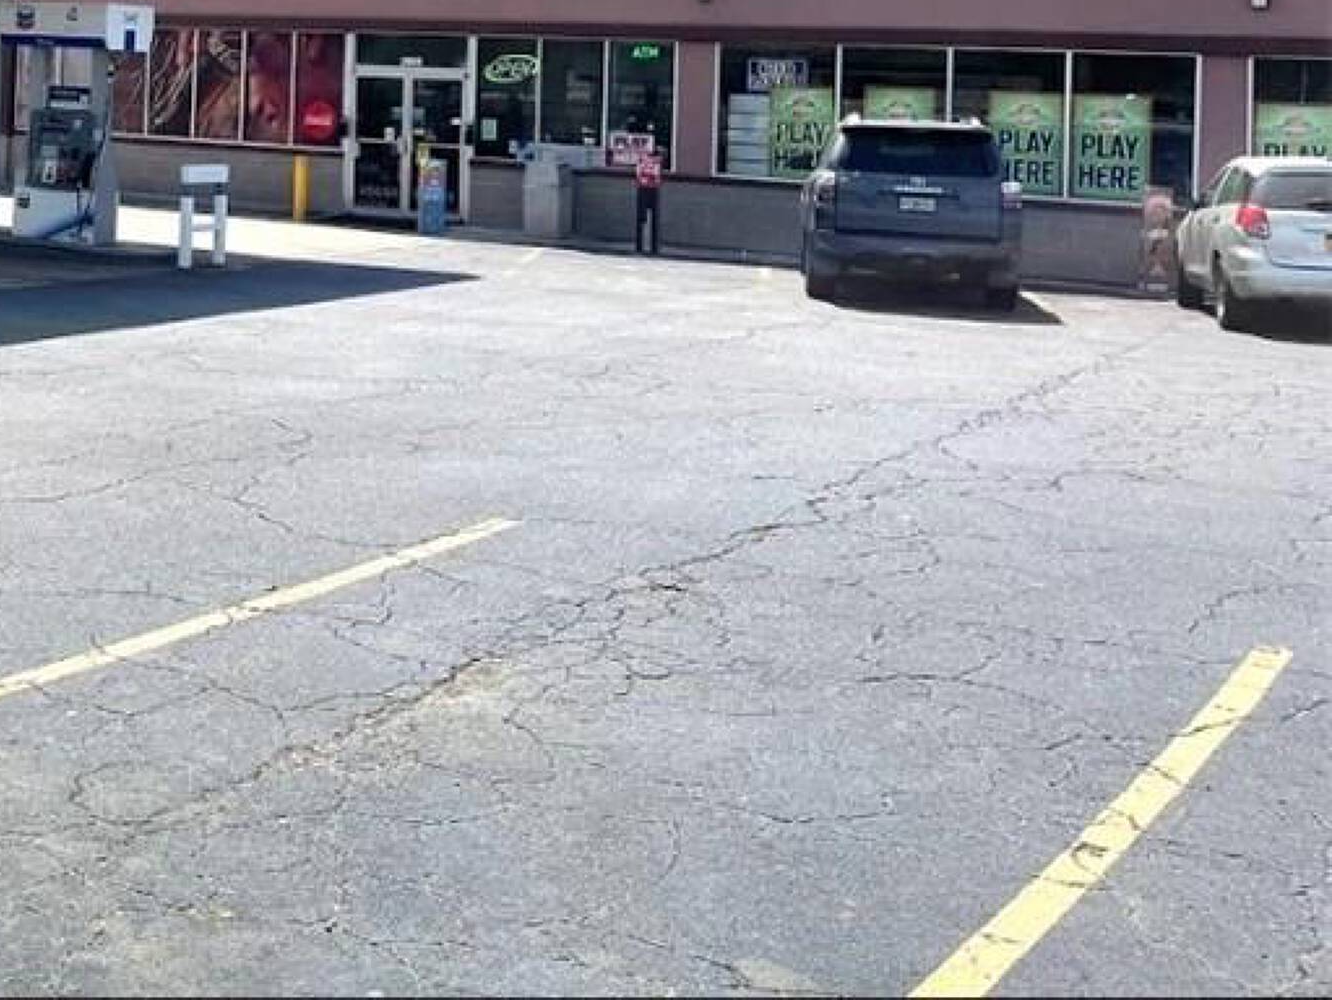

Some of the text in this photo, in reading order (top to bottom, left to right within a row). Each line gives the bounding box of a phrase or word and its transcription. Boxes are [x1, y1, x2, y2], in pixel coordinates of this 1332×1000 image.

[633, 46, 660, 58] ATM
[488, 59, 537, 79] OPEN
[776, 122, 826, 143] PLAY
[998, 129, 1054, 153] PLAY
[1081, 133, 1140, 159] PLAY
[1079, 163, 1140, 190] HERE
